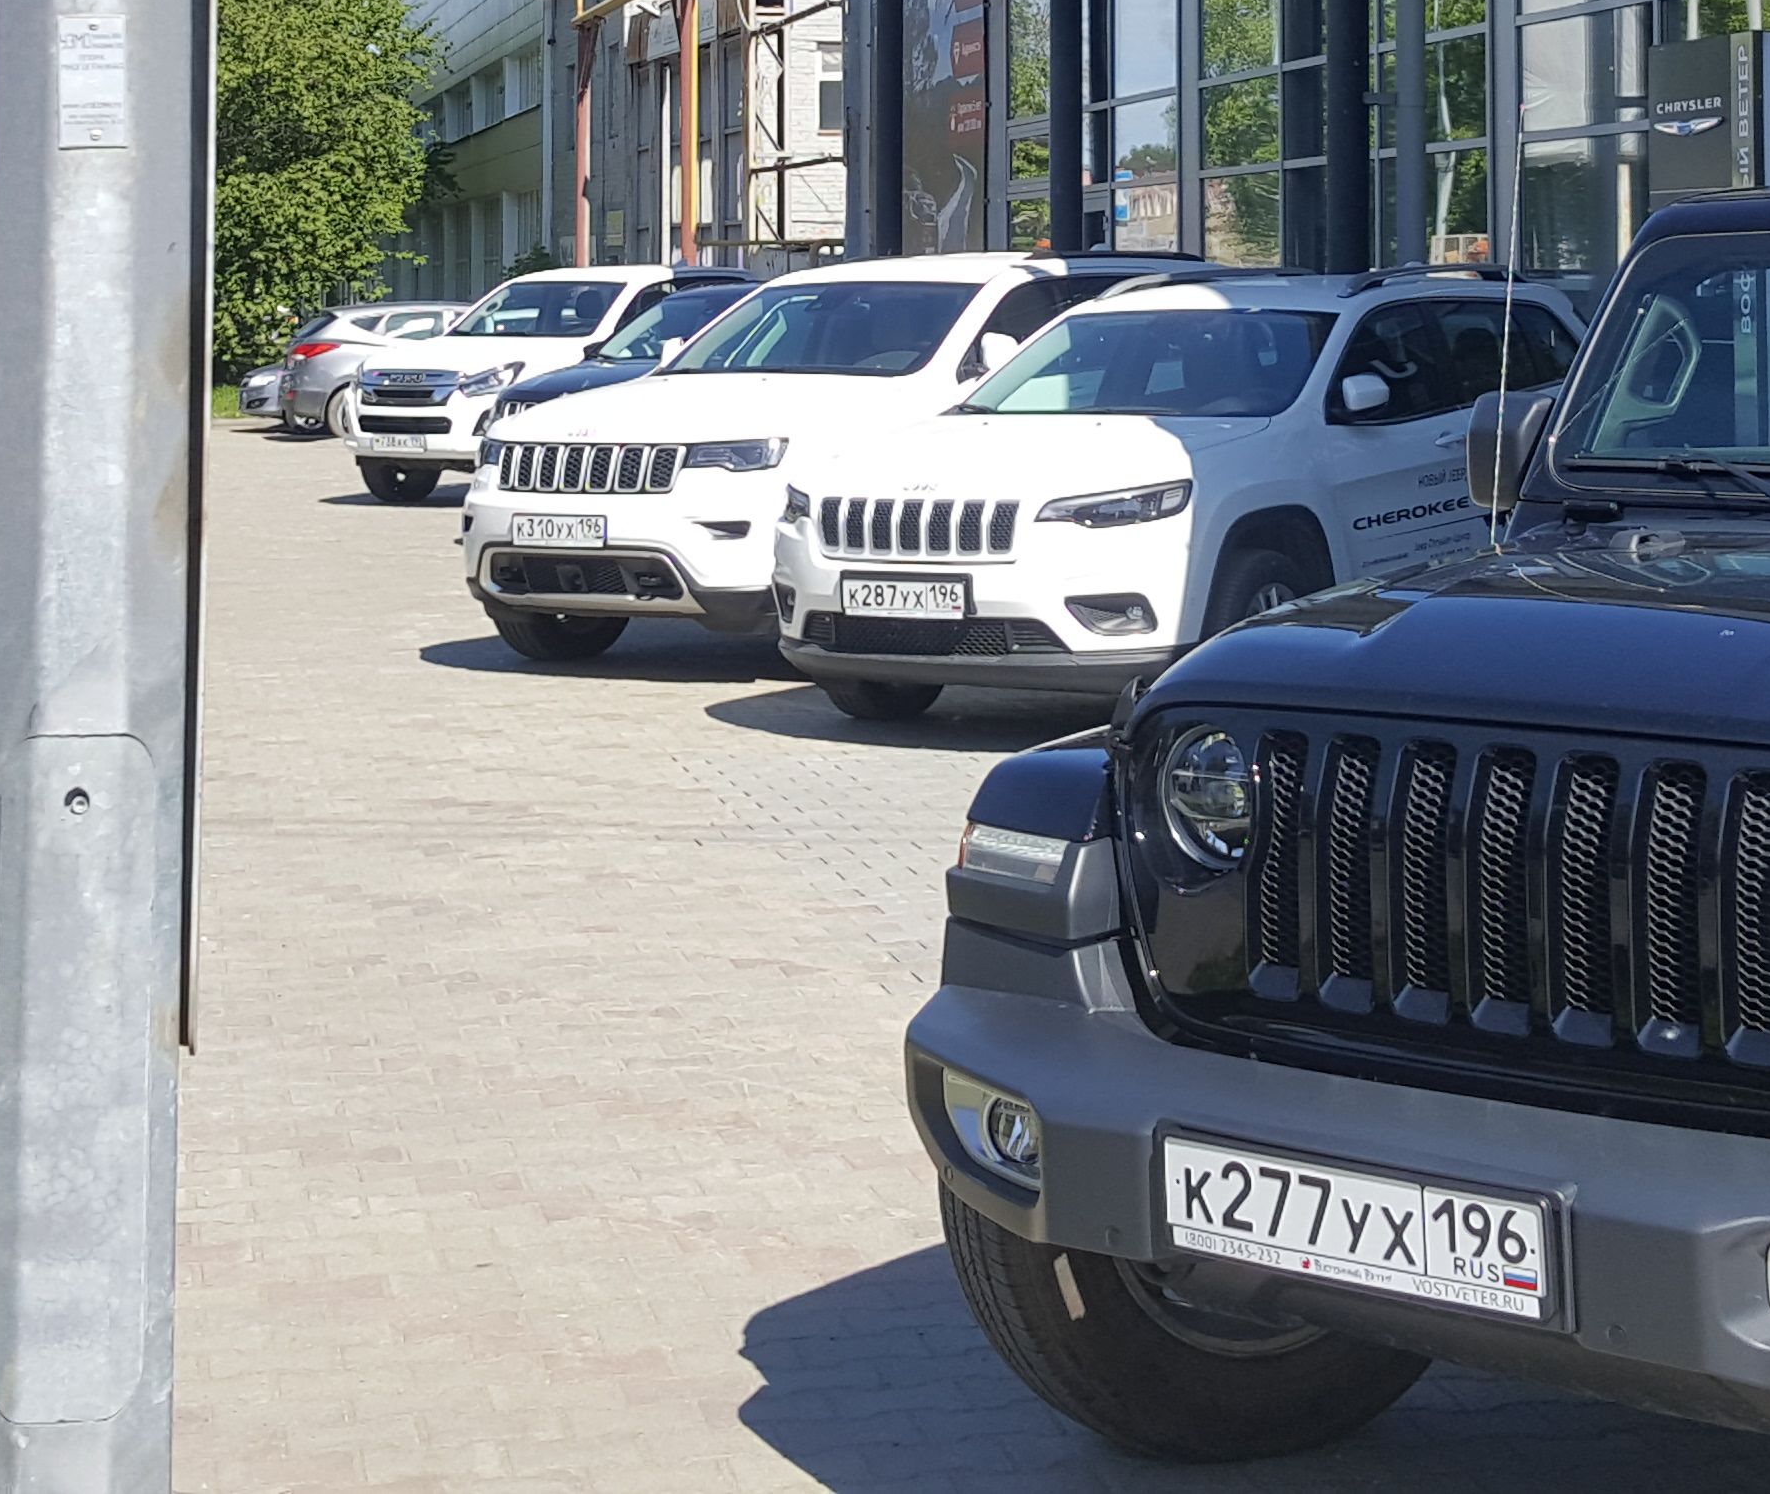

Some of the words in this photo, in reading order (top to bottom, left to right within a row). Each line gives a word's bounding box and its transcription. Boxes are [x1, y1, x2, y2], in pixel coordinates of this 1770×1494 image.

[1656, 96, 1722, 115] CHRYSLER
[1353, 495, 1471, 530] CHEROKEE
[1431, 1198, 1527, 1264] 196
[1453, 1256, 1501, 1283] RUS
[1413, 1277, 1524, 1312] VOSTVETER.RU
